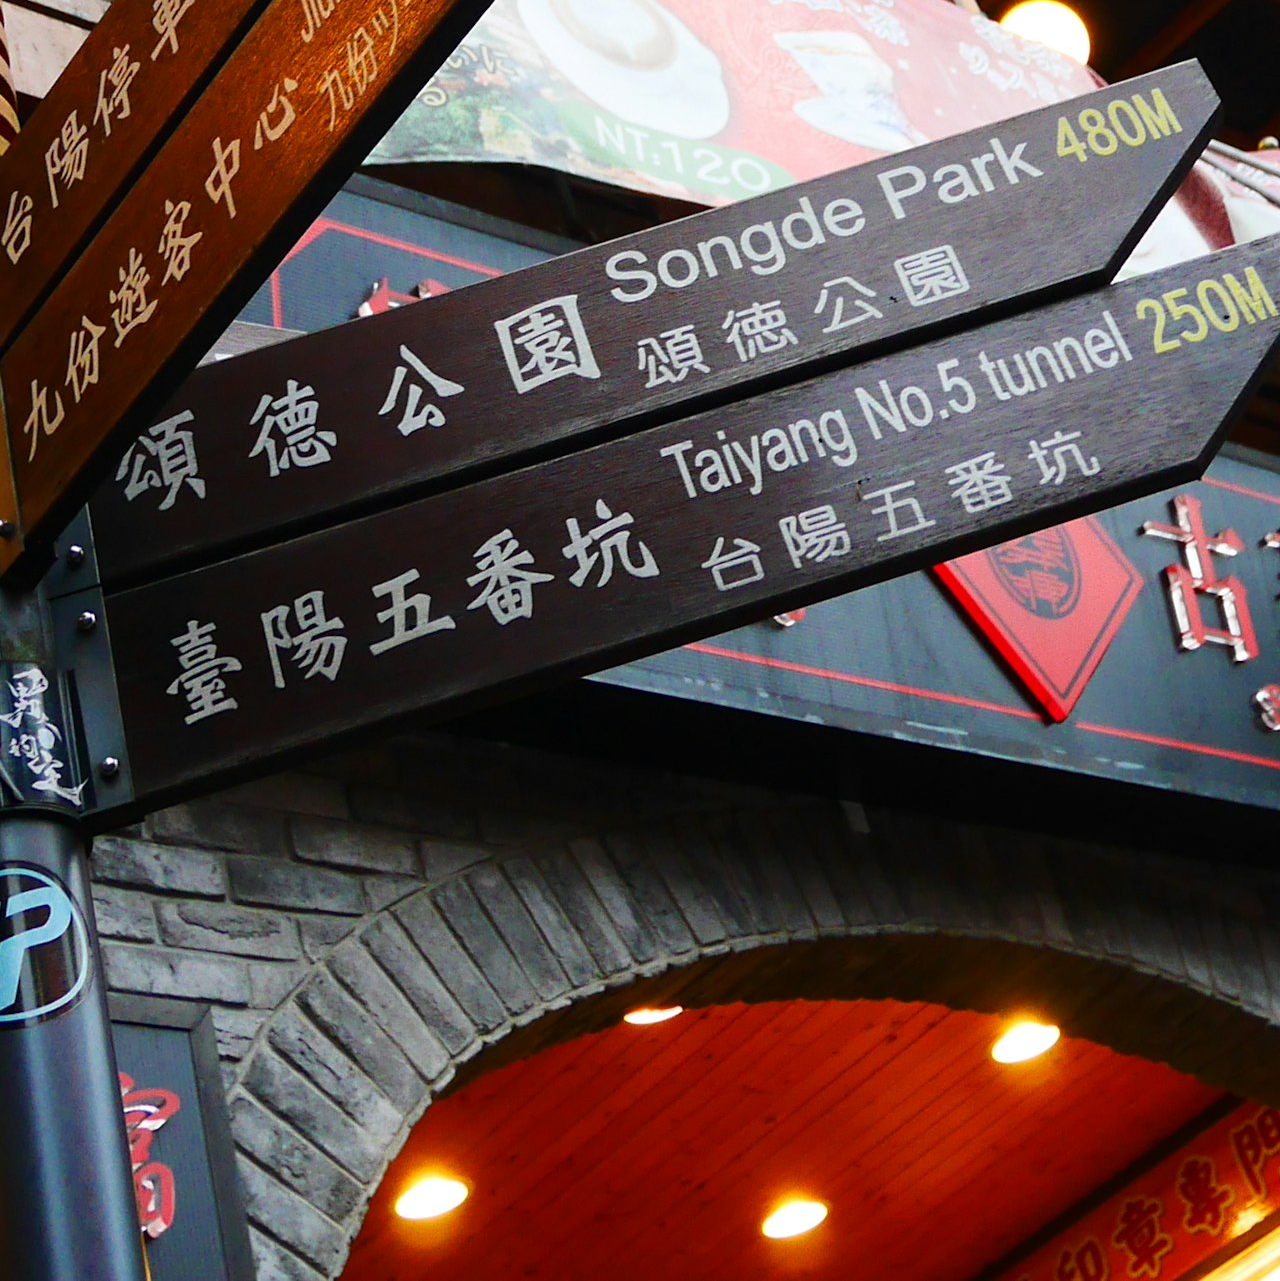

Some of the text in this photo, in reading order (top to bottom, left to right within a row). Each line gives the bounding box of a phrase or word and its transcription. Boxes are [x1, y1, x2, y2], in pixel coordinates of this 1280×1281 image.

[23, 76, 297, 463] 九份遊客中心
[606, 87, 1182, 305] Songde Park 480M
[115, 294, 601, 510] 頌德公園
[661, 266, 1278, 500] Taiyang No.5 tunnel 250M
[165, 498, 659, 724] 臺陽五番坑
[701, 430, 1100, 591] 台陽五番坑
